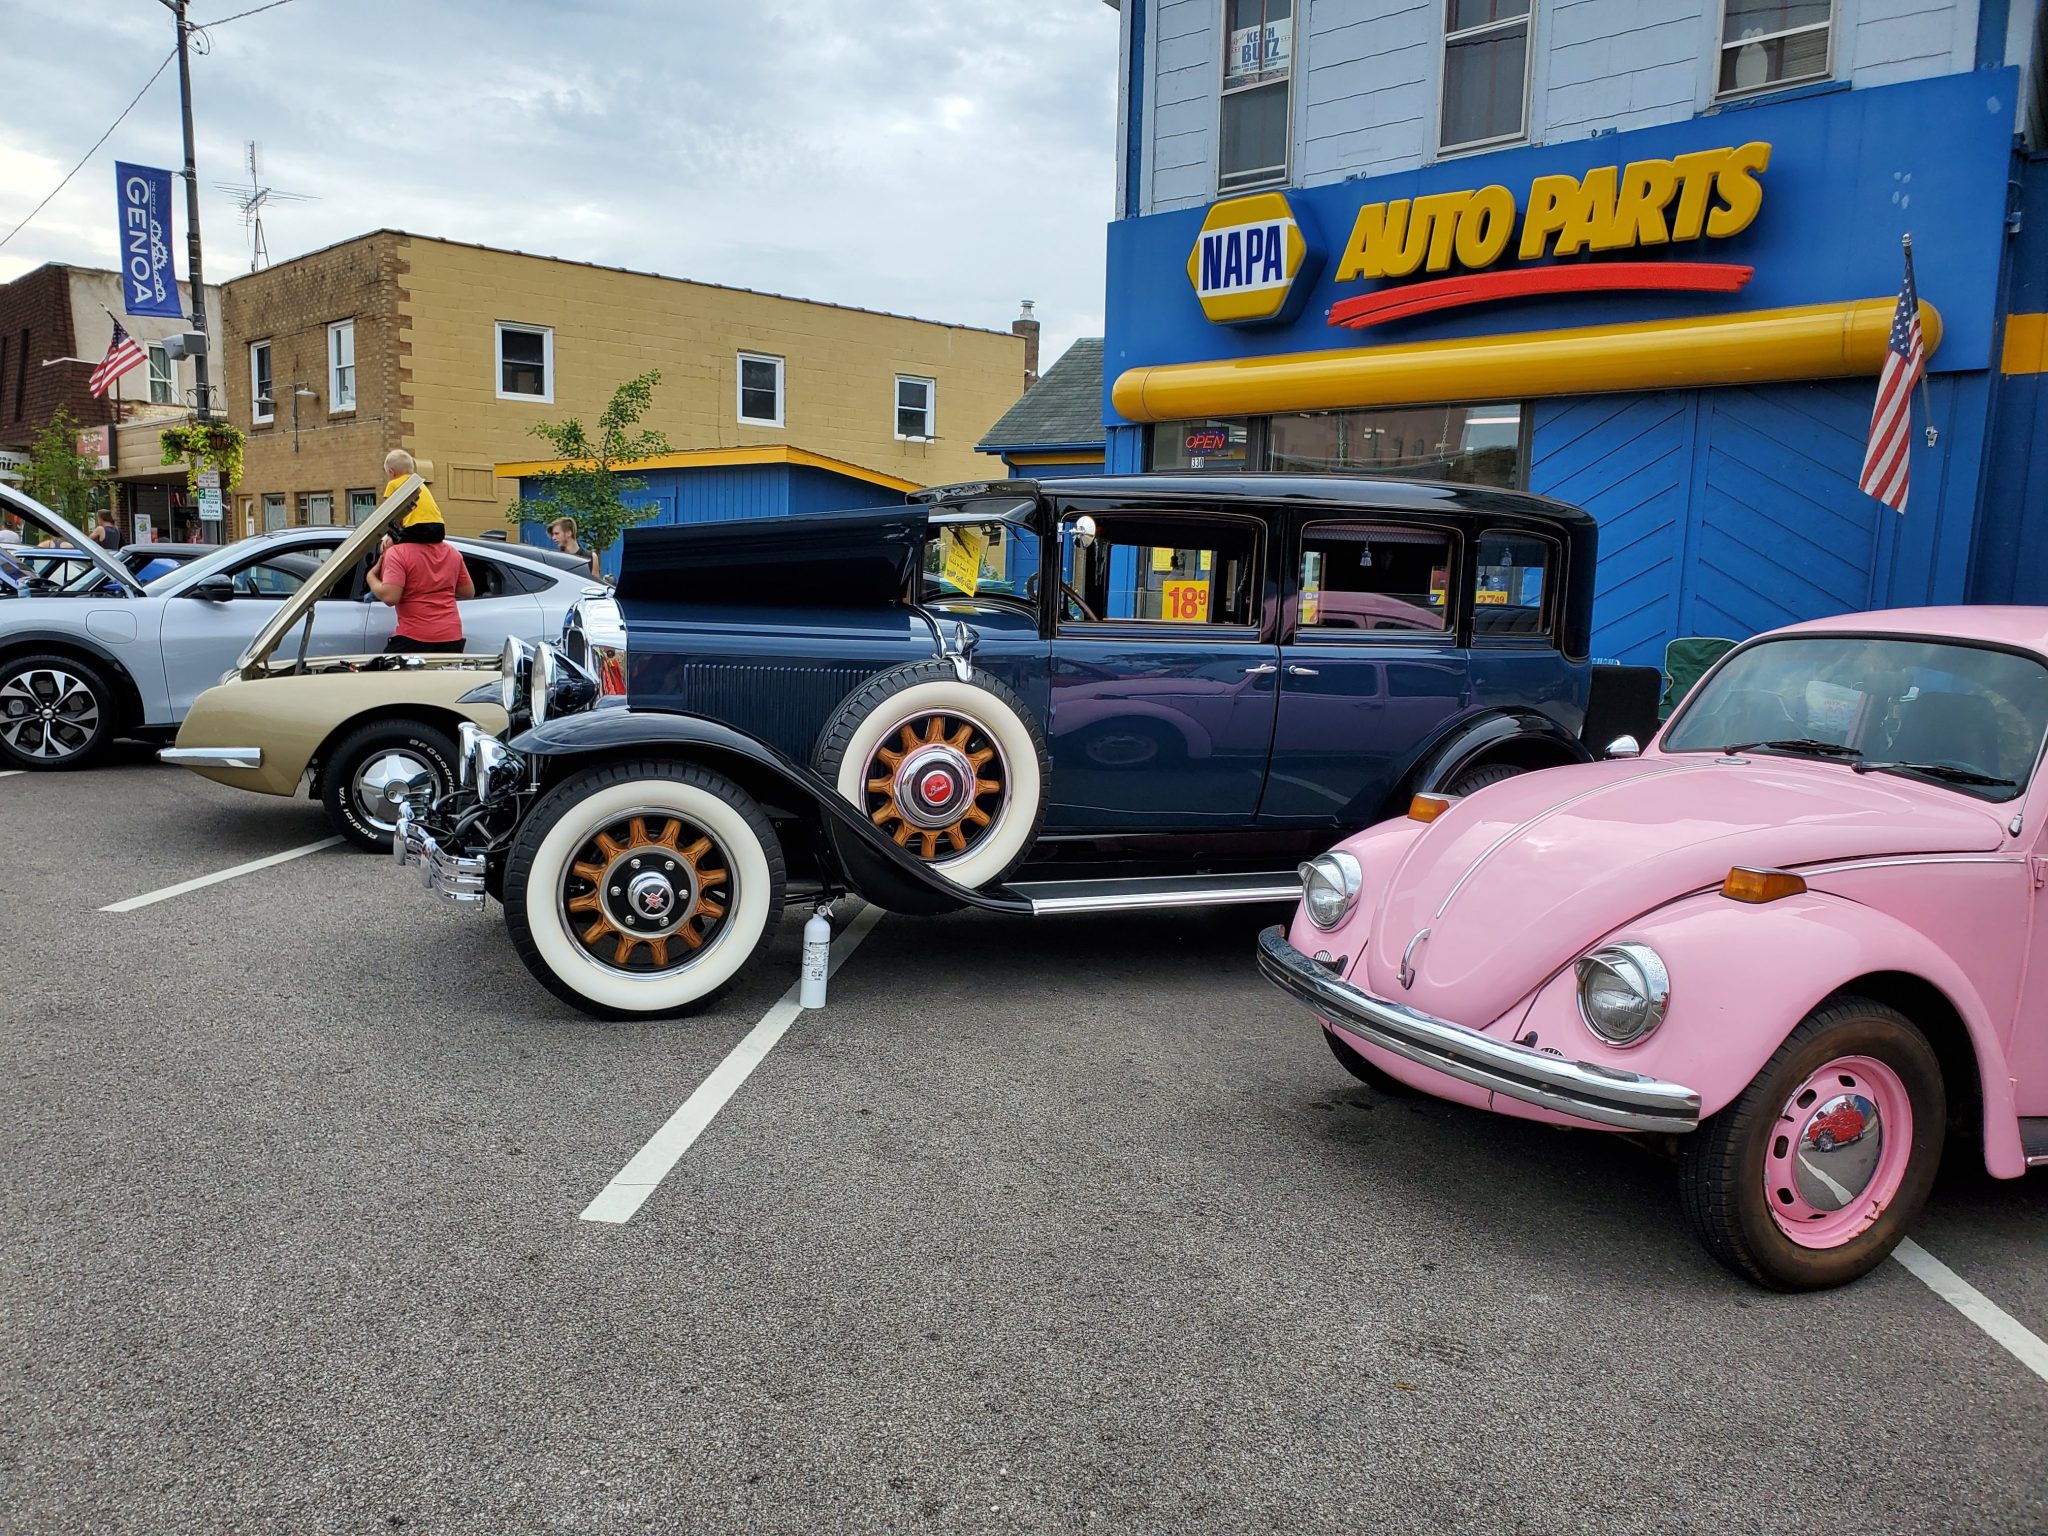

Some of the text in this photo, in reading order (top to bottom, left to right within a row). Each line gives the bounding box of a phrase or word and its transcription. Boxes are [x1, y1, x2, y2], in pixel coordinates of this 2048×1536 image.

[1241, 37, 1280, 64] BUTZ
[1246, 27, 1275, 44] KETH
[1335, 141, 1772, 283] AUTO PARTS
[126, 176, 153, 304] GENOA
[1202, 225, 1283, 291] NAPA
[1185, 434, 1226, 449] OPEN
[199, 490, 204, 498] 2
[409, 739, 455, 803] BFGoodric
[343, 808, 379, 841] Radial
